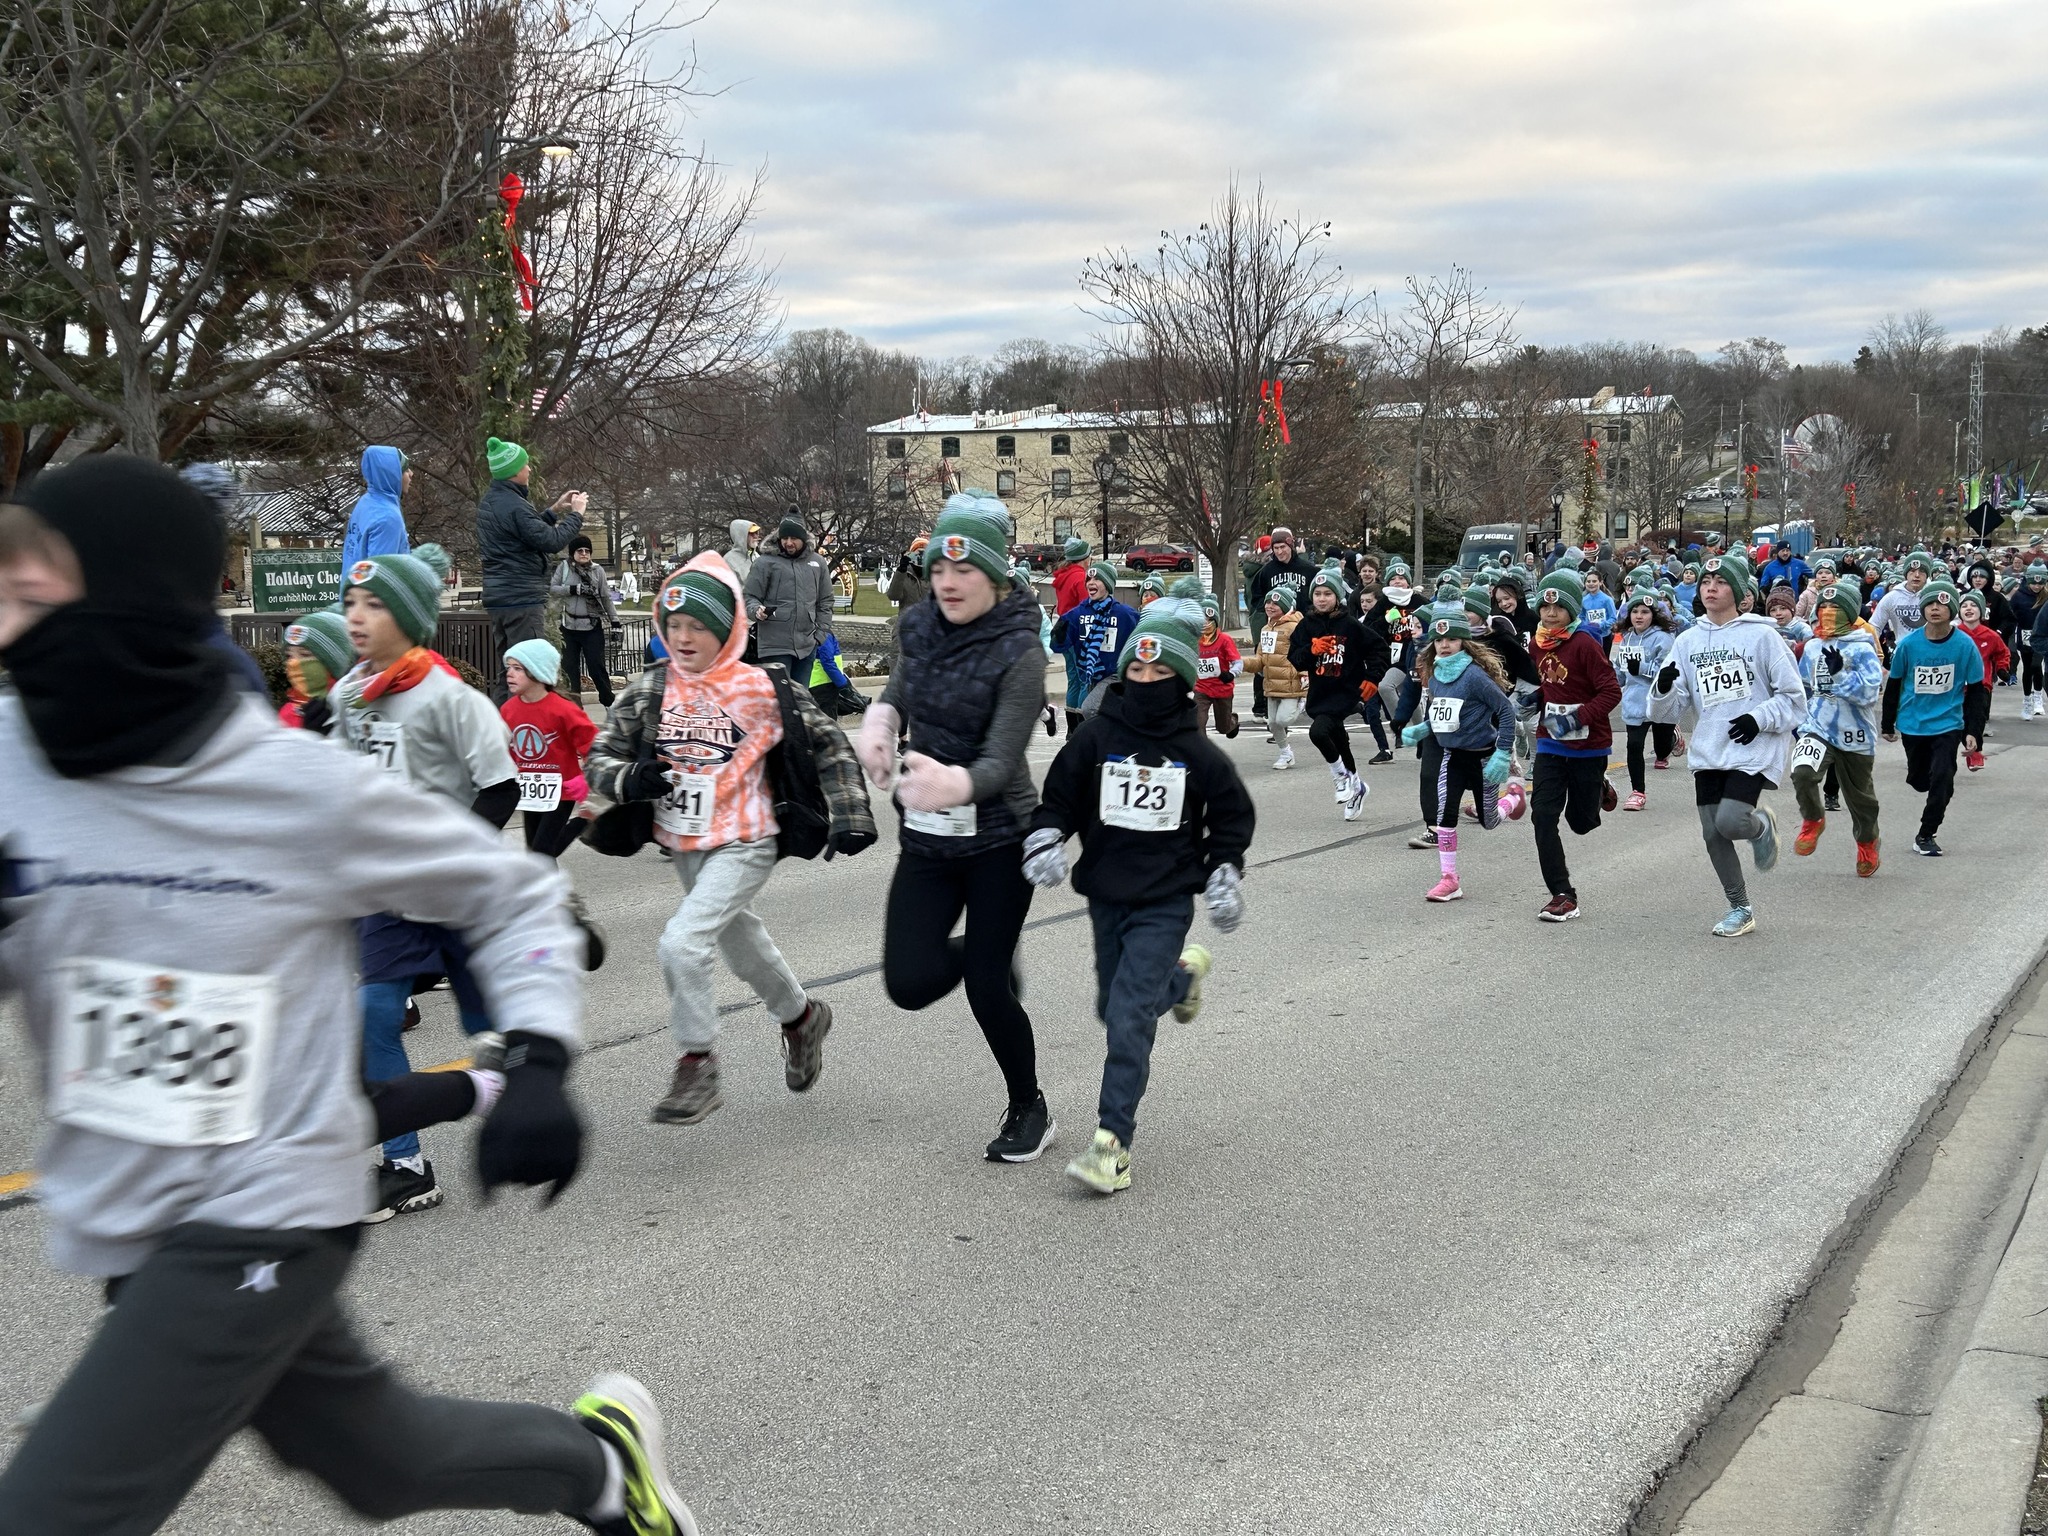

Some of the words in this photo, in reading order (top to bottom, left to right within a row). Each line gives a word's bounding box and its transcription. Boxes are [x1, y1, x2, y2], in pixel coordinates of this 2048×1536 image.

[265, 571, 314, 589] Holiday
[1271, 572, 1306, 587] ILLINOIS
[268, 595, 278, 603] on
[279, 592, 300, 603] exhibit
[301, 592, 317, 602] Nov.
[1896, 609, 1921, 617] ROYA
[1703, 670, 1743, 694] 1794
[1918, 671, 1951, 686] 2127
[1433, 706, 1452, 721] 750
[520, 782, 558, 799] 1907
[1118, 780, 1168, 811] 123
